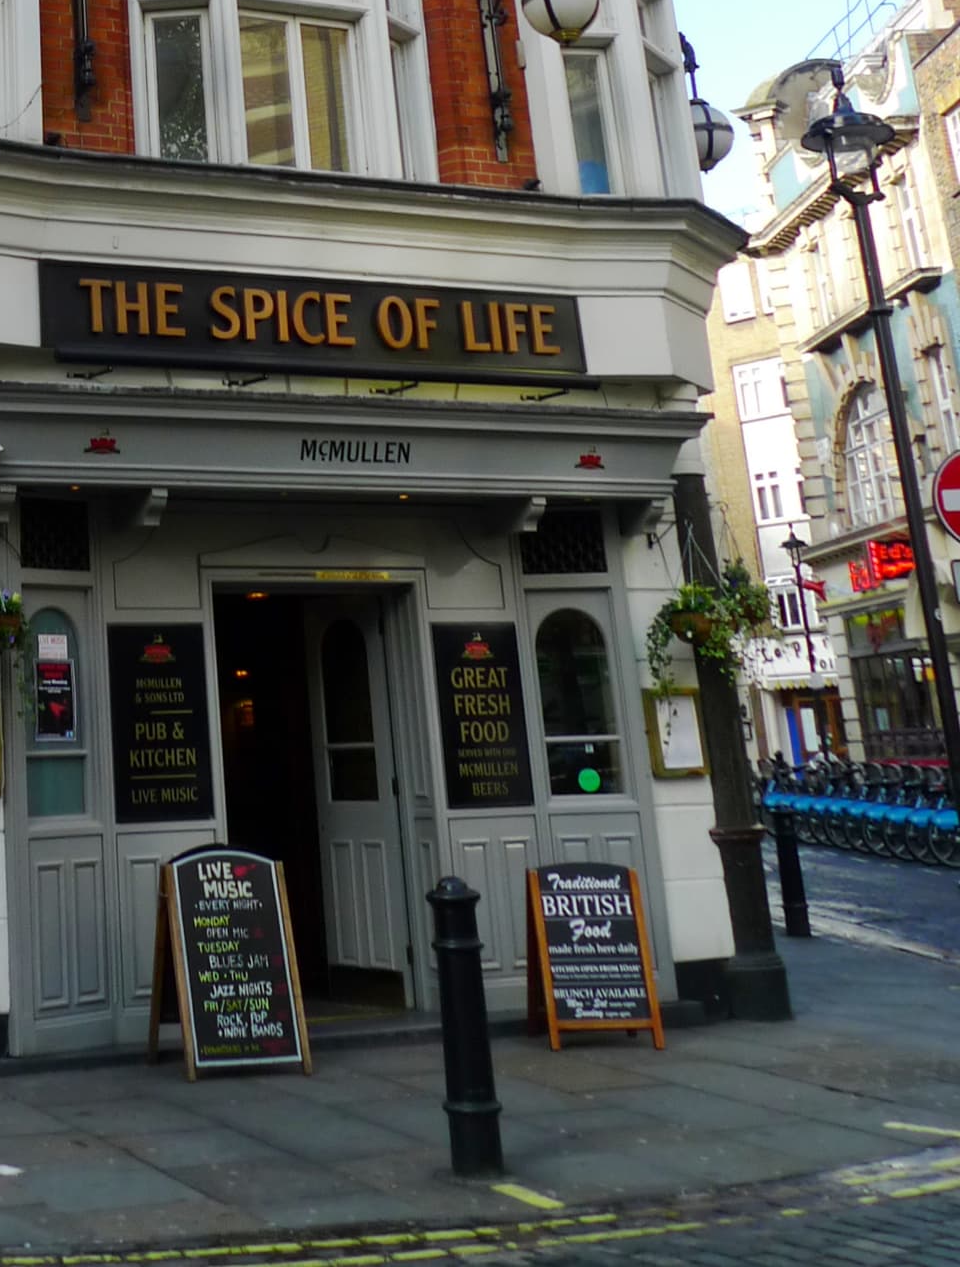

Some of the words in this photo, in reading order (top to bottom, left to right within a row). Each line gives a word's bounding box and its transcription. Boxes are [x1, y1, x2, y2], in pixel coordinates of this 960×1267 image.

[78, 277, 186, 337] THE
[209, 284, 357, 347] SPICE
[376, 295, 439, 350] OF
[459, 298, 562, 356] LIFE
[450, 666, 509, 689] GREAT
[144, 692, 167, 703] SONS
[168, 691, 185, 704] LTD
[453, 693, 511, 716] FRESH
[134, 721, 168, 741] PUB
[172, 720, 185, 740] &
[459, 720, 510, 744] FOOD
[129, 747, 197, 768] KITCHEN
[131, 788, 158, 804] LIVE
[160, 786, 199, 803] MUSIC
[472, 781, 509, 797] BEERS
[197, 861, 233, 881] LIVE
[203, 880, 253, 899] MUSIC
[547, 872, 621, 891] Traditional
[541, 894, 633, 917] BRITISH
[193, 915, 230, 928] MONDAY
[569, 918, 612, 942] Food
[206, 927, 228, 938] OPEN
[232, 927, 249, 938] MIC
[197, 941, 240, 954] TUESDAY
[548, 944, 572, 955] made
[574, 943, 595, 955] fresh
[596, 943, 616, 955] here
[618, 942, 638, 956] daily
[209, 955, 244, 969] BLUES
[247, 954, 269, 969] JAM
[198, 971, 220, 983] WED
[229, 970, 249, 982] THU
[210, 984, 236, 999] JAZZ
[238, 981, 272, 997] NIGHTS
[554, 987, 593, 999] BRUNCH
[594, 987, 647, 999] AVAILABLE
[250, 1011, 268, 1025] POP
[251, 1022, 284, 1039] BANDS
